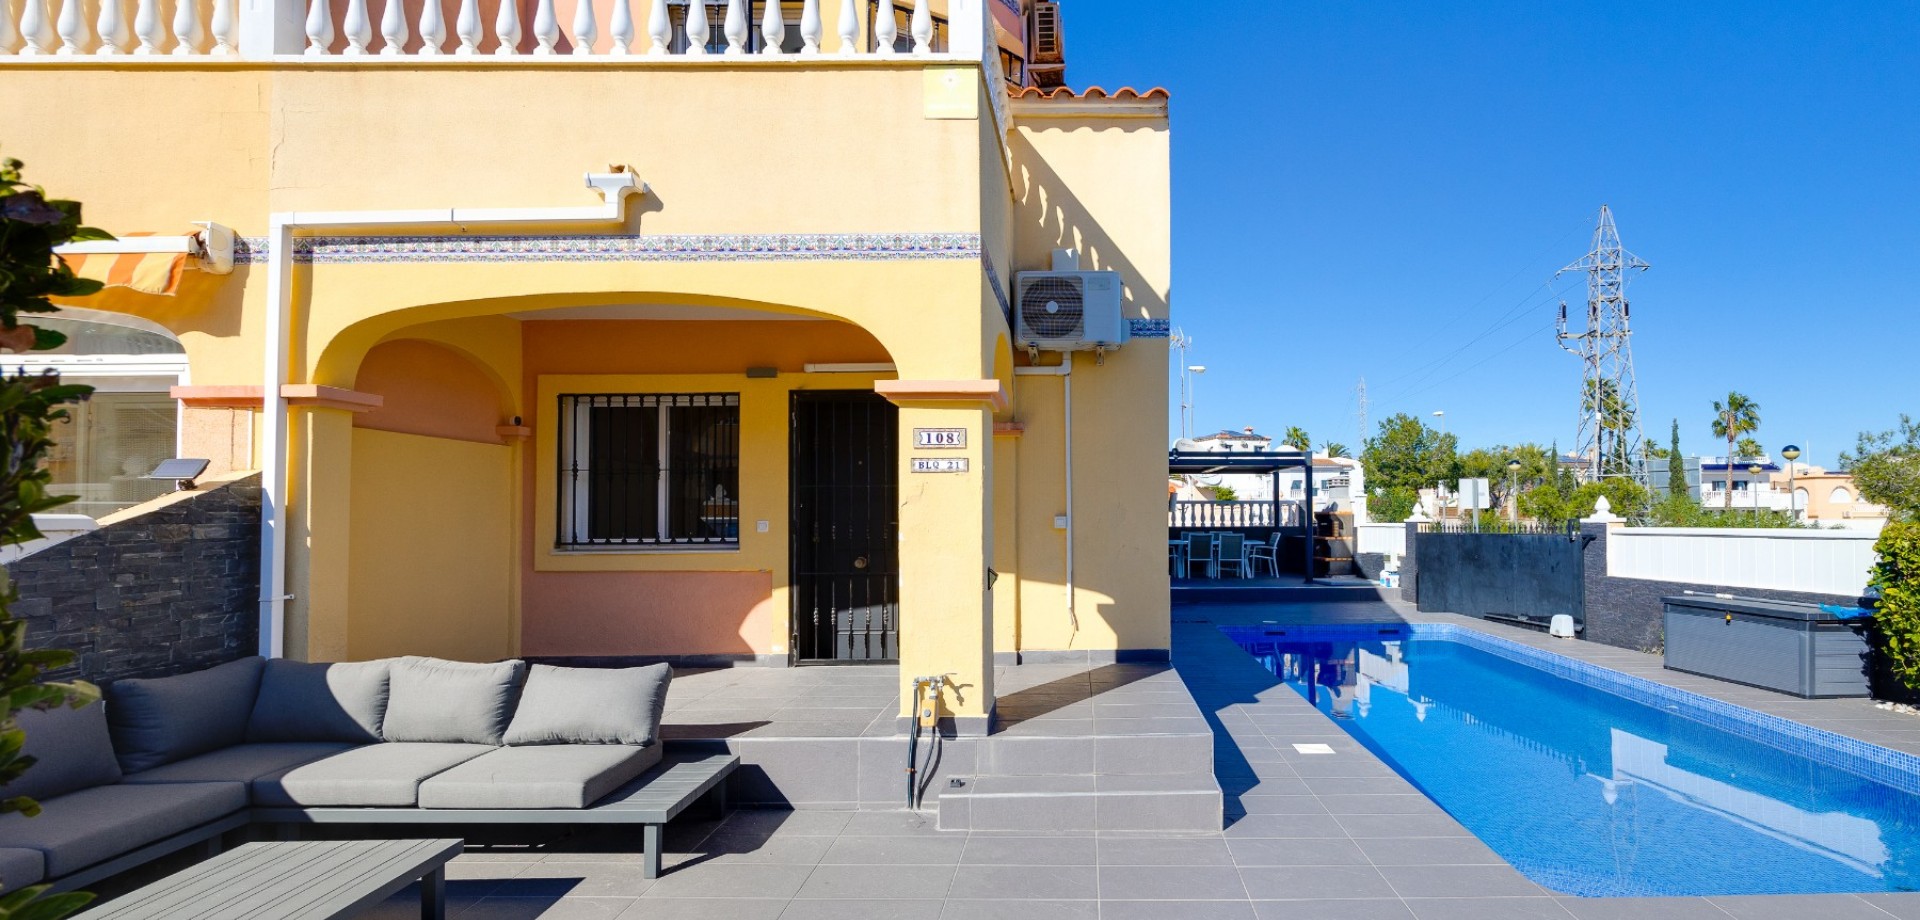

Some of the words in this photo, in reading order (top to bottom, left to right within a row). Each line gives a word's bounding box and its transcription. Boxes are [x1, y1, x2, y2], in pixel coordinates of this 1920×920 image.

[926, 432, 954, 444] 108
[918, 461, 940, 470] BLQ
[947, 461, 960, 470] 21
